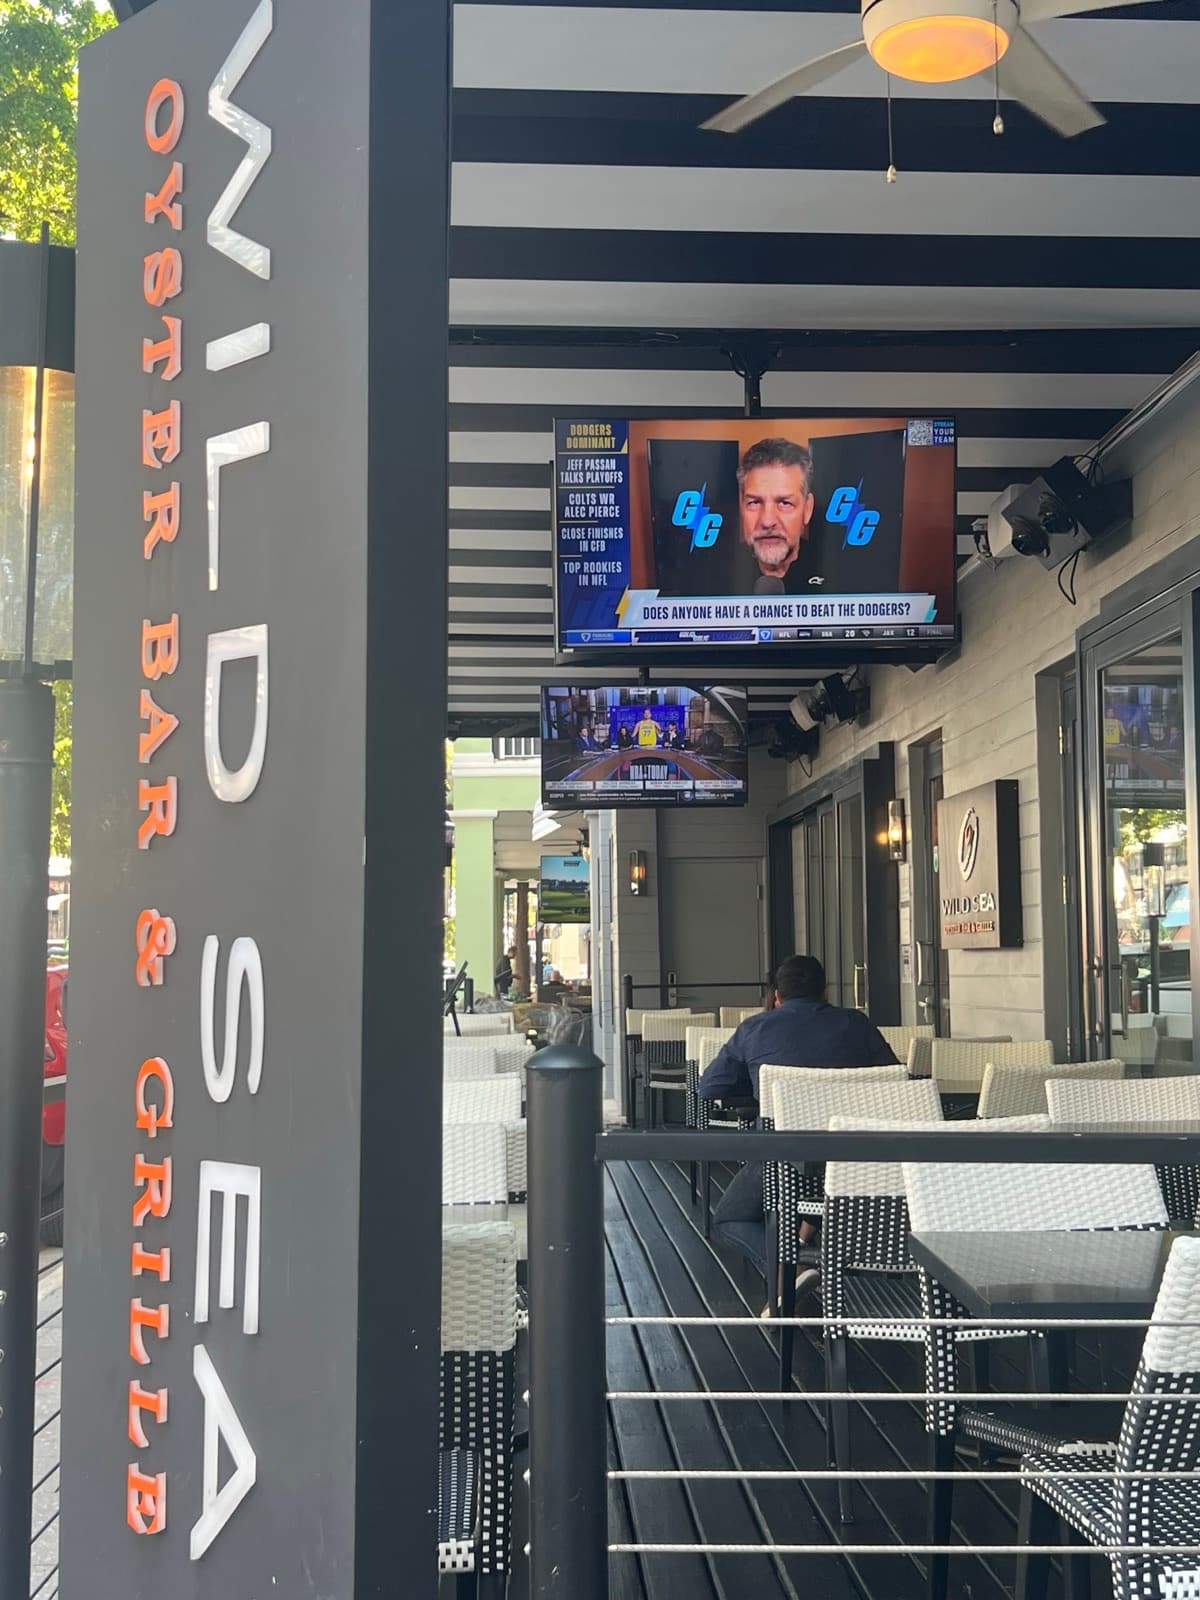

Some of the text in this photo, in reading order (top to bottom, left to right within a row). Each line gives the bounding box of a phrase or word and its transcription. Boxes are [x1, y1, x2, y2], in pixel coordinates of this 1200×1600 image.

[570, 424, 612, 436] DODGERS
[566, 437, 616, 449] DOMINANT
[934, 436, 954, 444] TEAM
[567, 458, 616, 471] JEFF PASSAN
[560, 471, 623, 484] TALKS PLAYOFFS
[569, 493, 615, 505] COLTS WR
[564, 506, 620, 518] ALEC PIERCE
[561, 527, 624, 540] CLOSE FINISHES
[580, 540, 606, 552] IN CFB
[564, 561, 622, 574] TOP ROOKIES
[578, 574, 608, 586] IN NFL
[643, 602, 911, 620] DOES ANYONE HAVE A CHANCE TO BEAT THE DODGERS?
[844, 630, 855, 638] 20
[906, 628, 915, 637] 12
[647, 764, 668, 780] TODAY
[190, 0, 273, 1560] WILD SEA
[127, 78, 185, 1535] OYSTER BAR & GRILLE
[942, 892, 996, 915] WILD SEA
